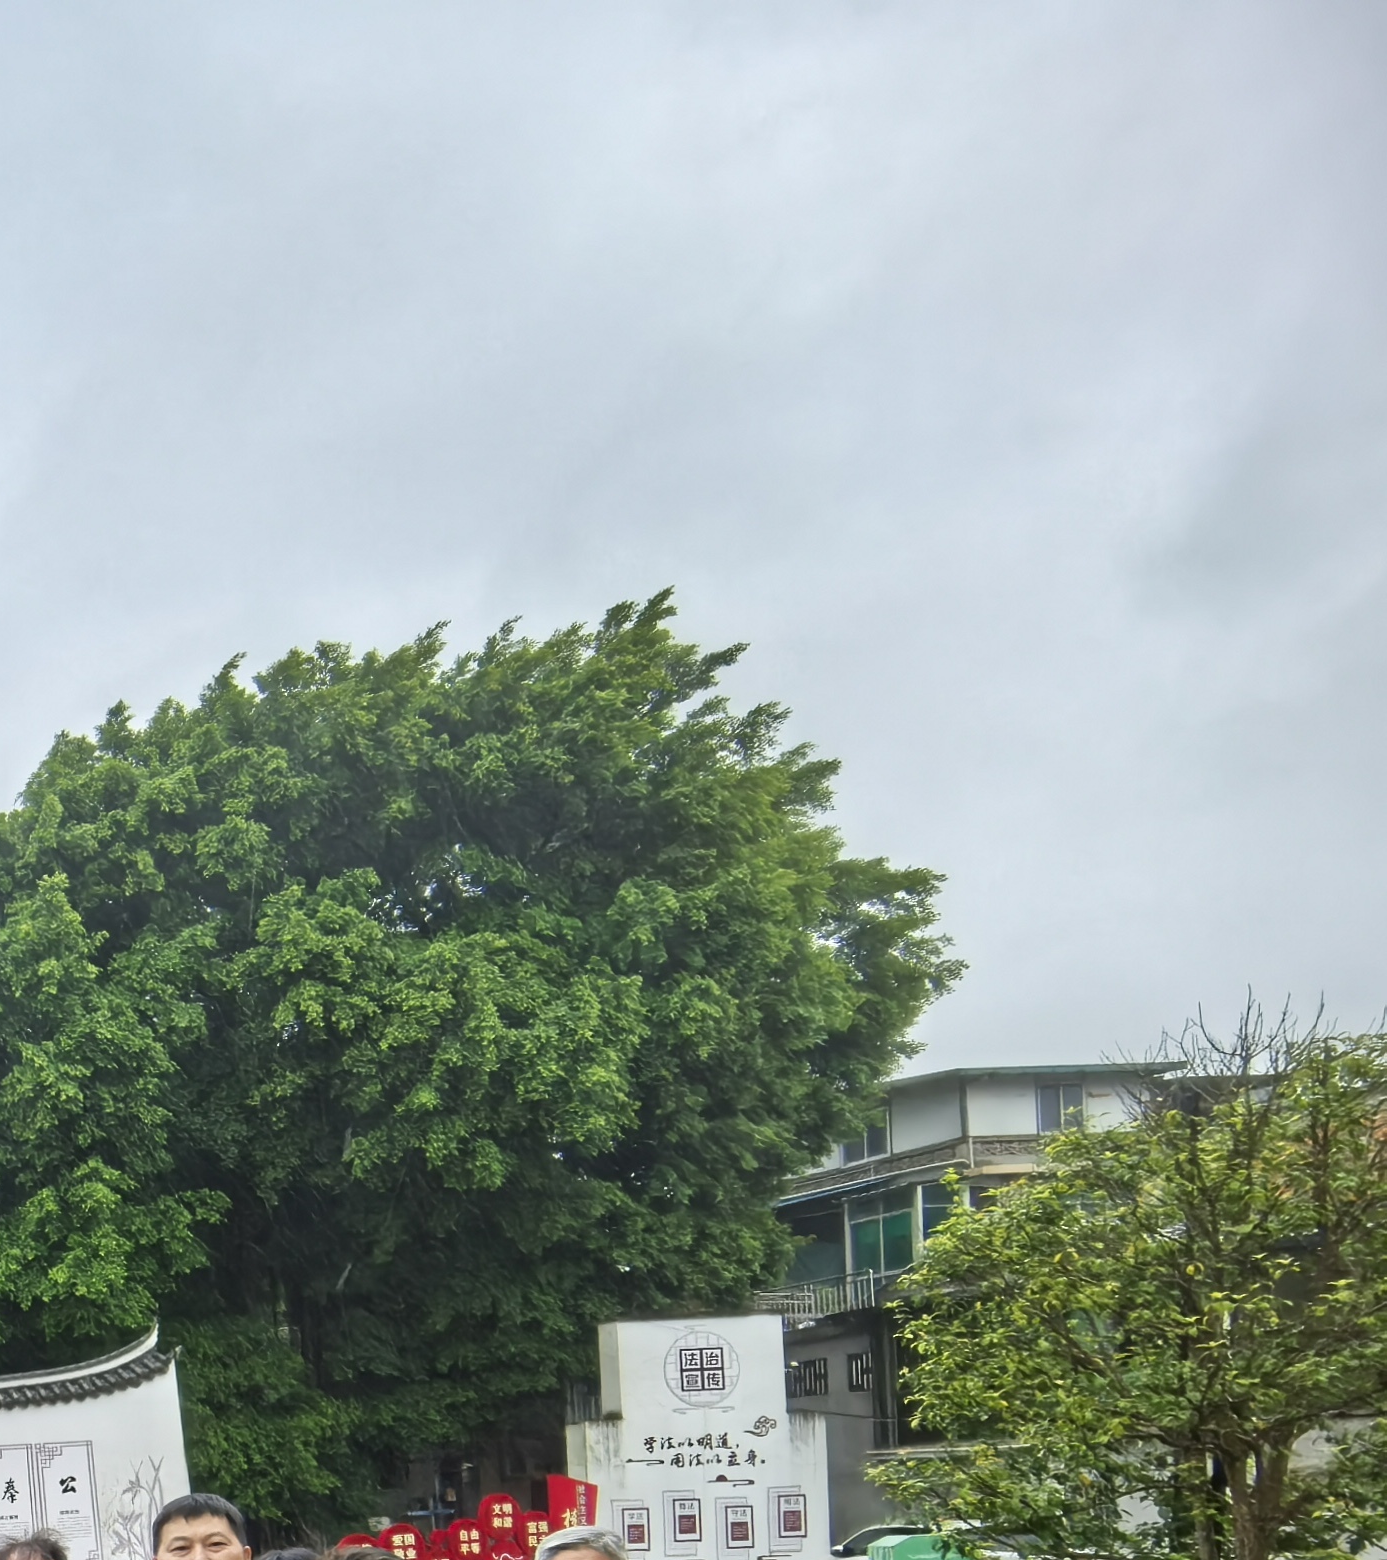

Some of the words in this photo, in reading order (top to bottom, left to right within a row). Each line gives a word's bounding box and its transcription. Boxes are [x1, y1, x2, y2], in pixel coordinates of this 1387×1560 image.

[684, 1352, 720, 1367] 法治
[685, 1373, 721, 1388] 宣传
[59, 1476, 77, 1494] 公
[492, 1504, 513, 1515] 文明
[492, 1517, 513, 1529] 和谐
[527, 1521, 549, 1533] 富强
[392, 1534, 415, 1546] 爱国
[459, 1528, 479, 1541] 自由
[460, 1541, 480, 1555] 平等
